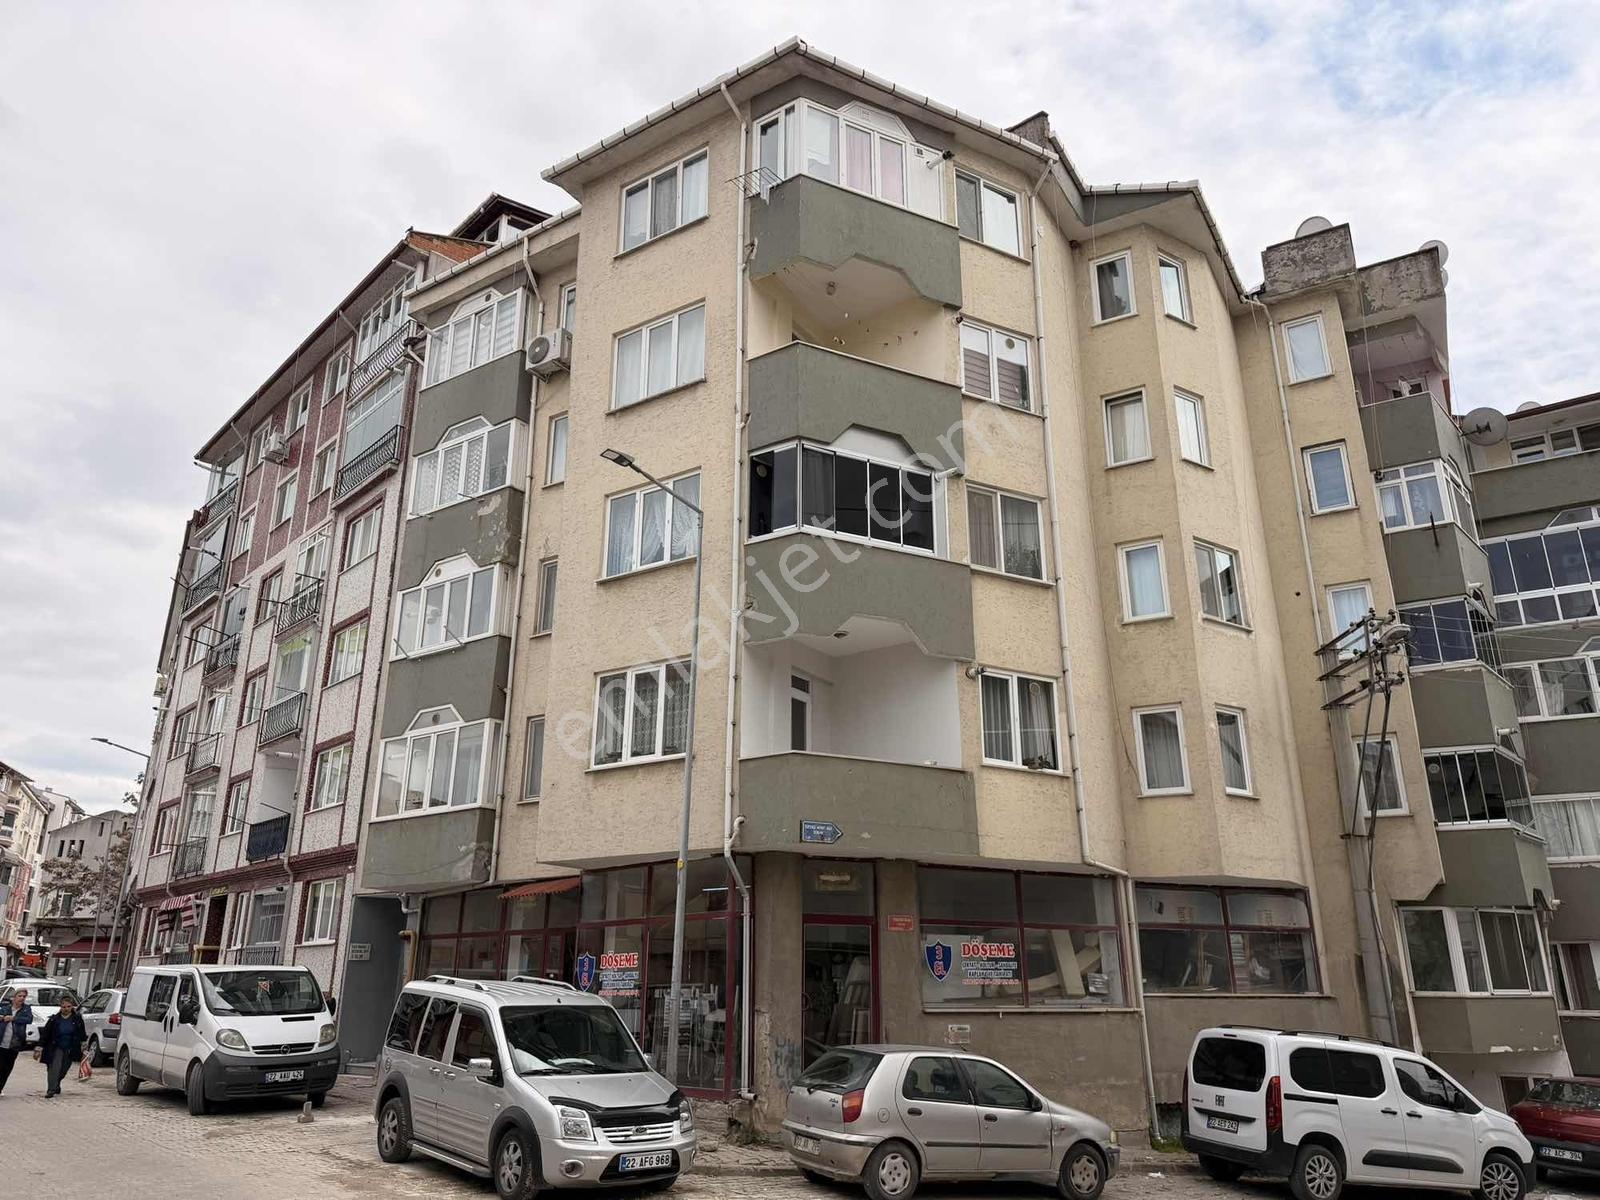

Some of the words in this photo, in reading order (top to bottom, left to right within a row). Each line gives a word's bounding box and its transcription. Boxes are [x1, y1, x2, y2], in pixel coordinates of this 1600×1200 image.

[961, 939, 1015, 960] DÖŞEME
[600, 951, 638, 971] DÖŞEME
[626, 1158, 636, 1168] 22
[639, 1156, 654, 1167] AFG
[655, 1154, 670, 1166] 968
